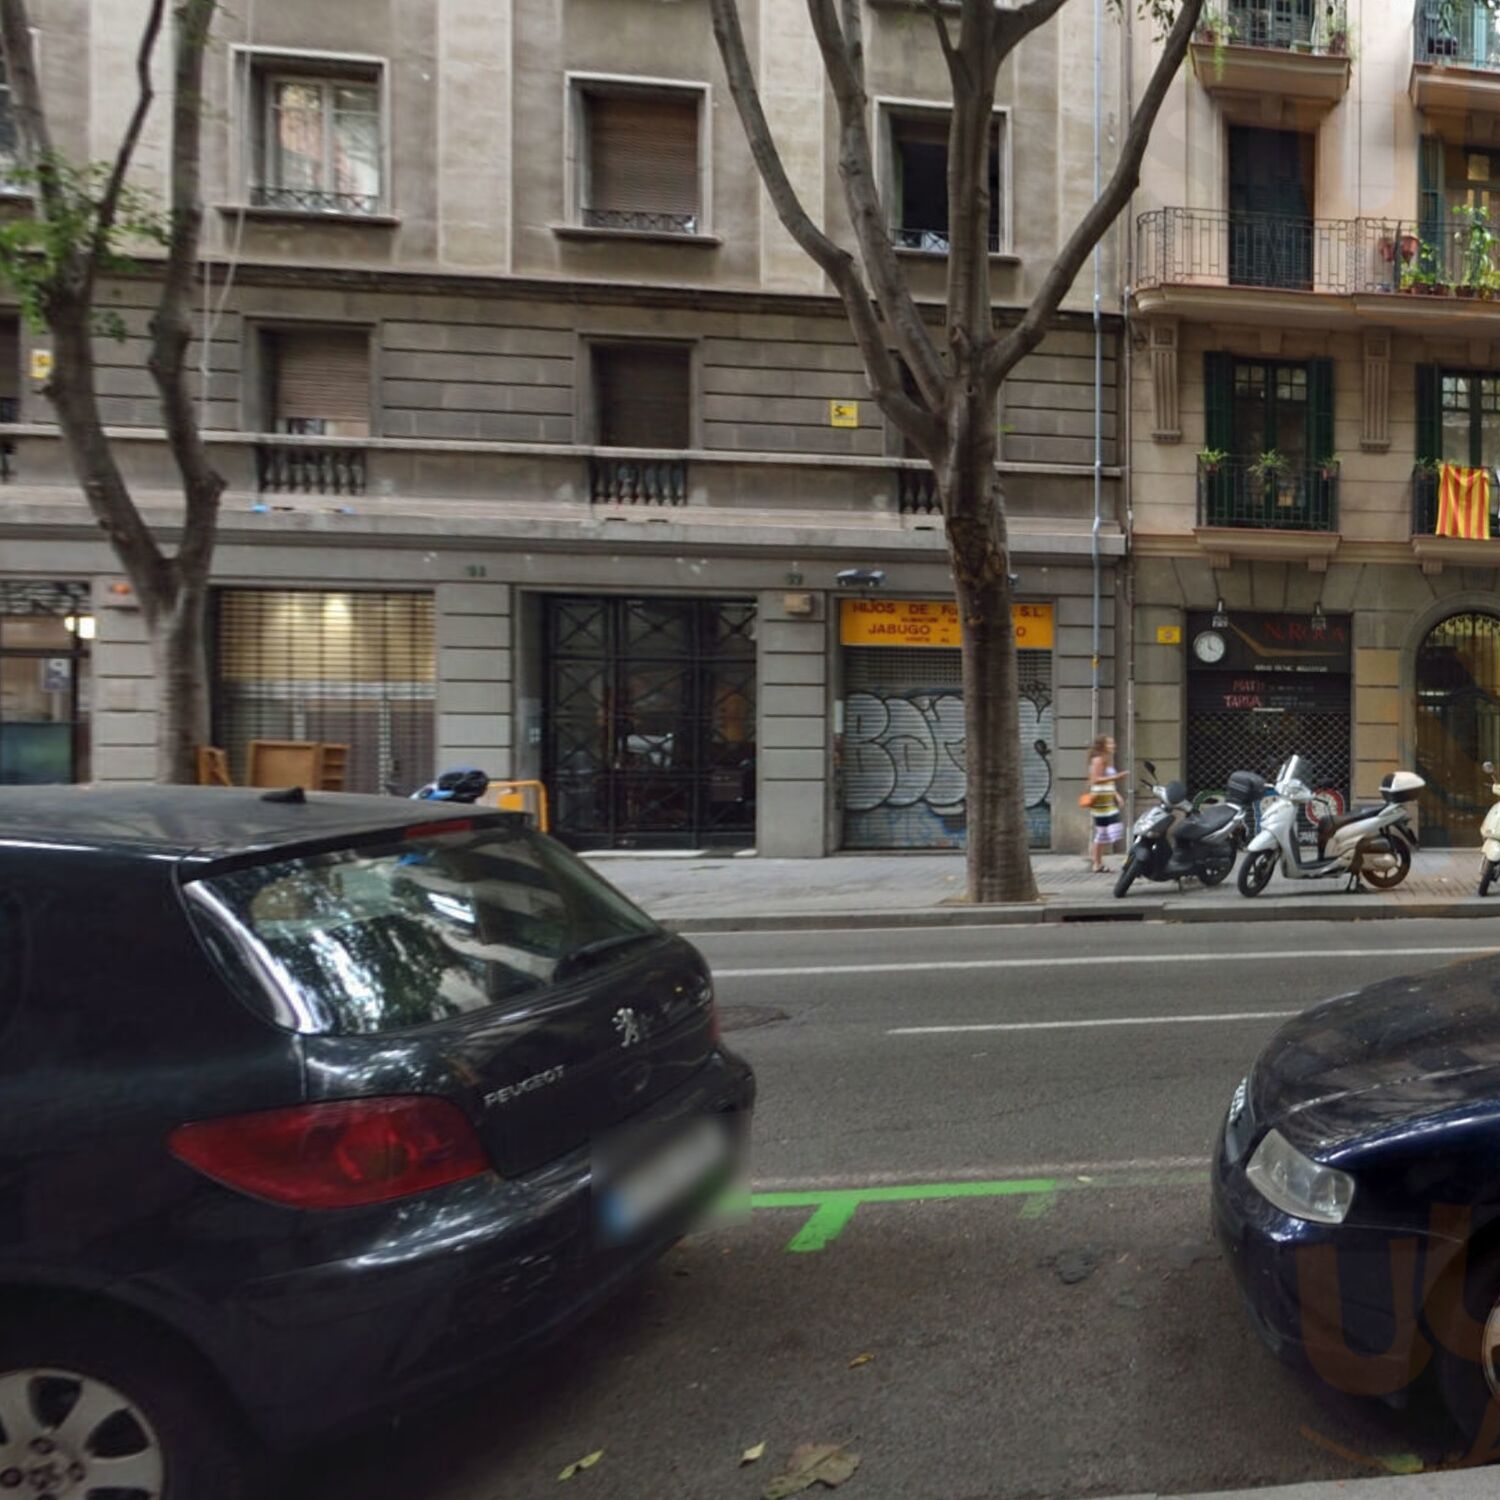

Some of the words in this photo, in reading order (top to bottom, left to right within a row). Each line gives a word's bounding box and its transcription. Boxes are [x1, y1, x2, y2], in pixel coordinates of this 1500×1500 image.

[853, 602, 896, 614] HIJOS
[908, 604, 928, 615] DE
[867, 623, 931, 635] JABUGO
[484, 1064, 566, 1107] PEUGEOT
